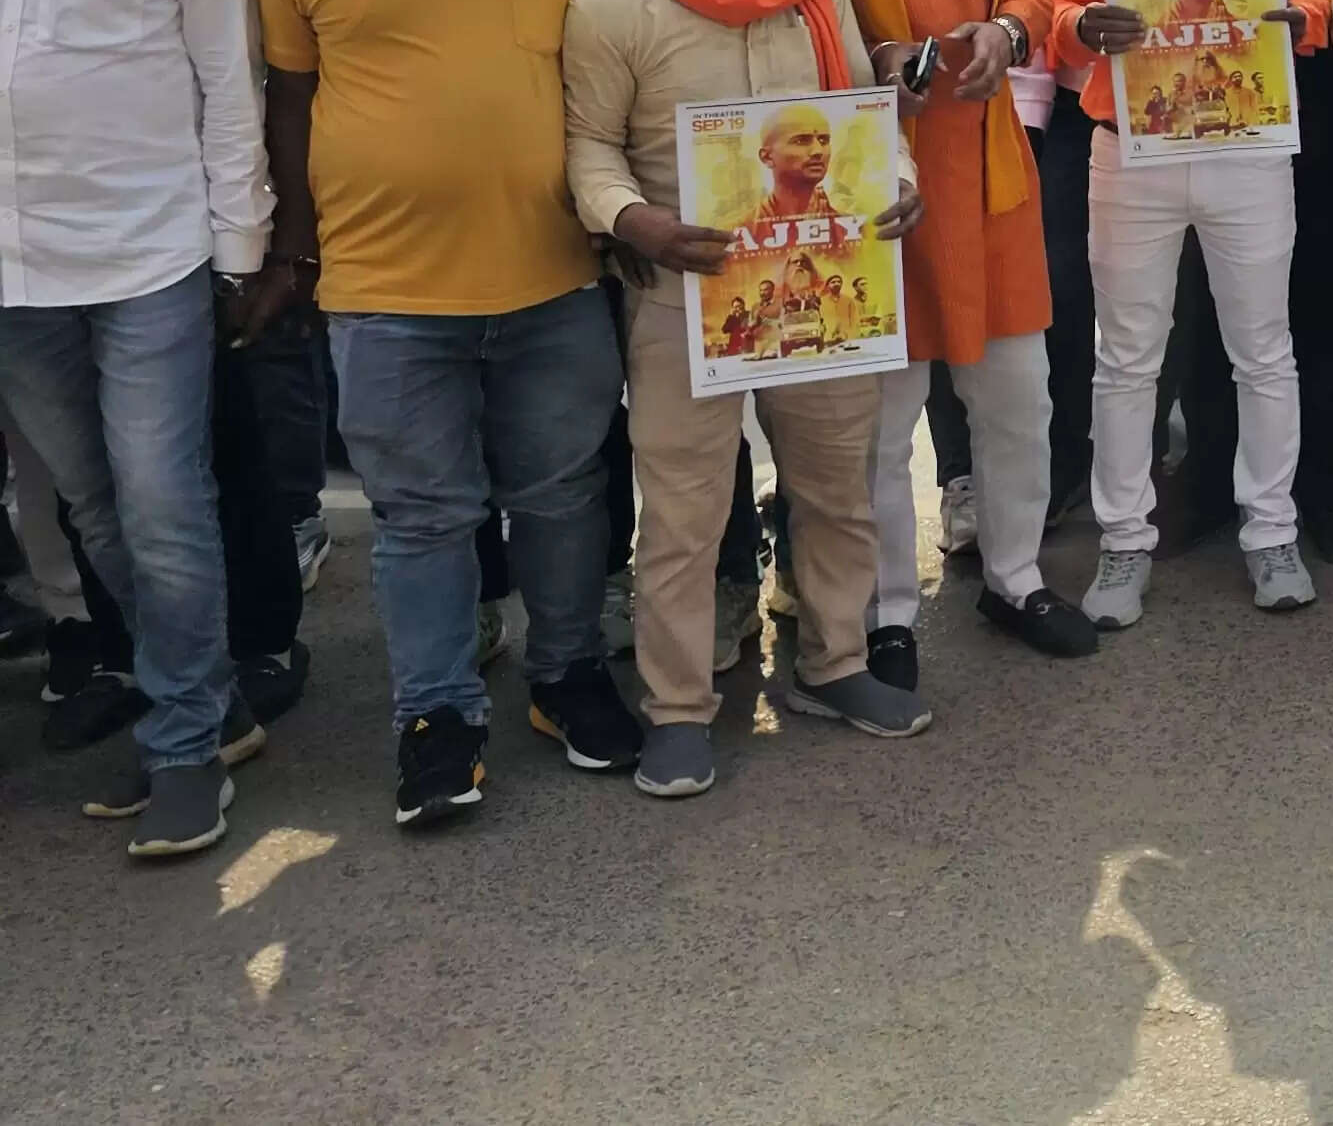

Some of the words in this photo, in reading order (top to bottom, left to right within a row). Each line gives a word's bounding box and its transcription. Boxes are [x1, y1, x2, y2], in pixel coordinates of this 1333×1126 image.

[1141, 18, 1262, 49] AJEY
[692, 118, 725, 133] SEP
[729, 117, 745, 131] 19
[704, 110, 746, 119] THEATERS
[724, 214, 869, 253] AJEY
